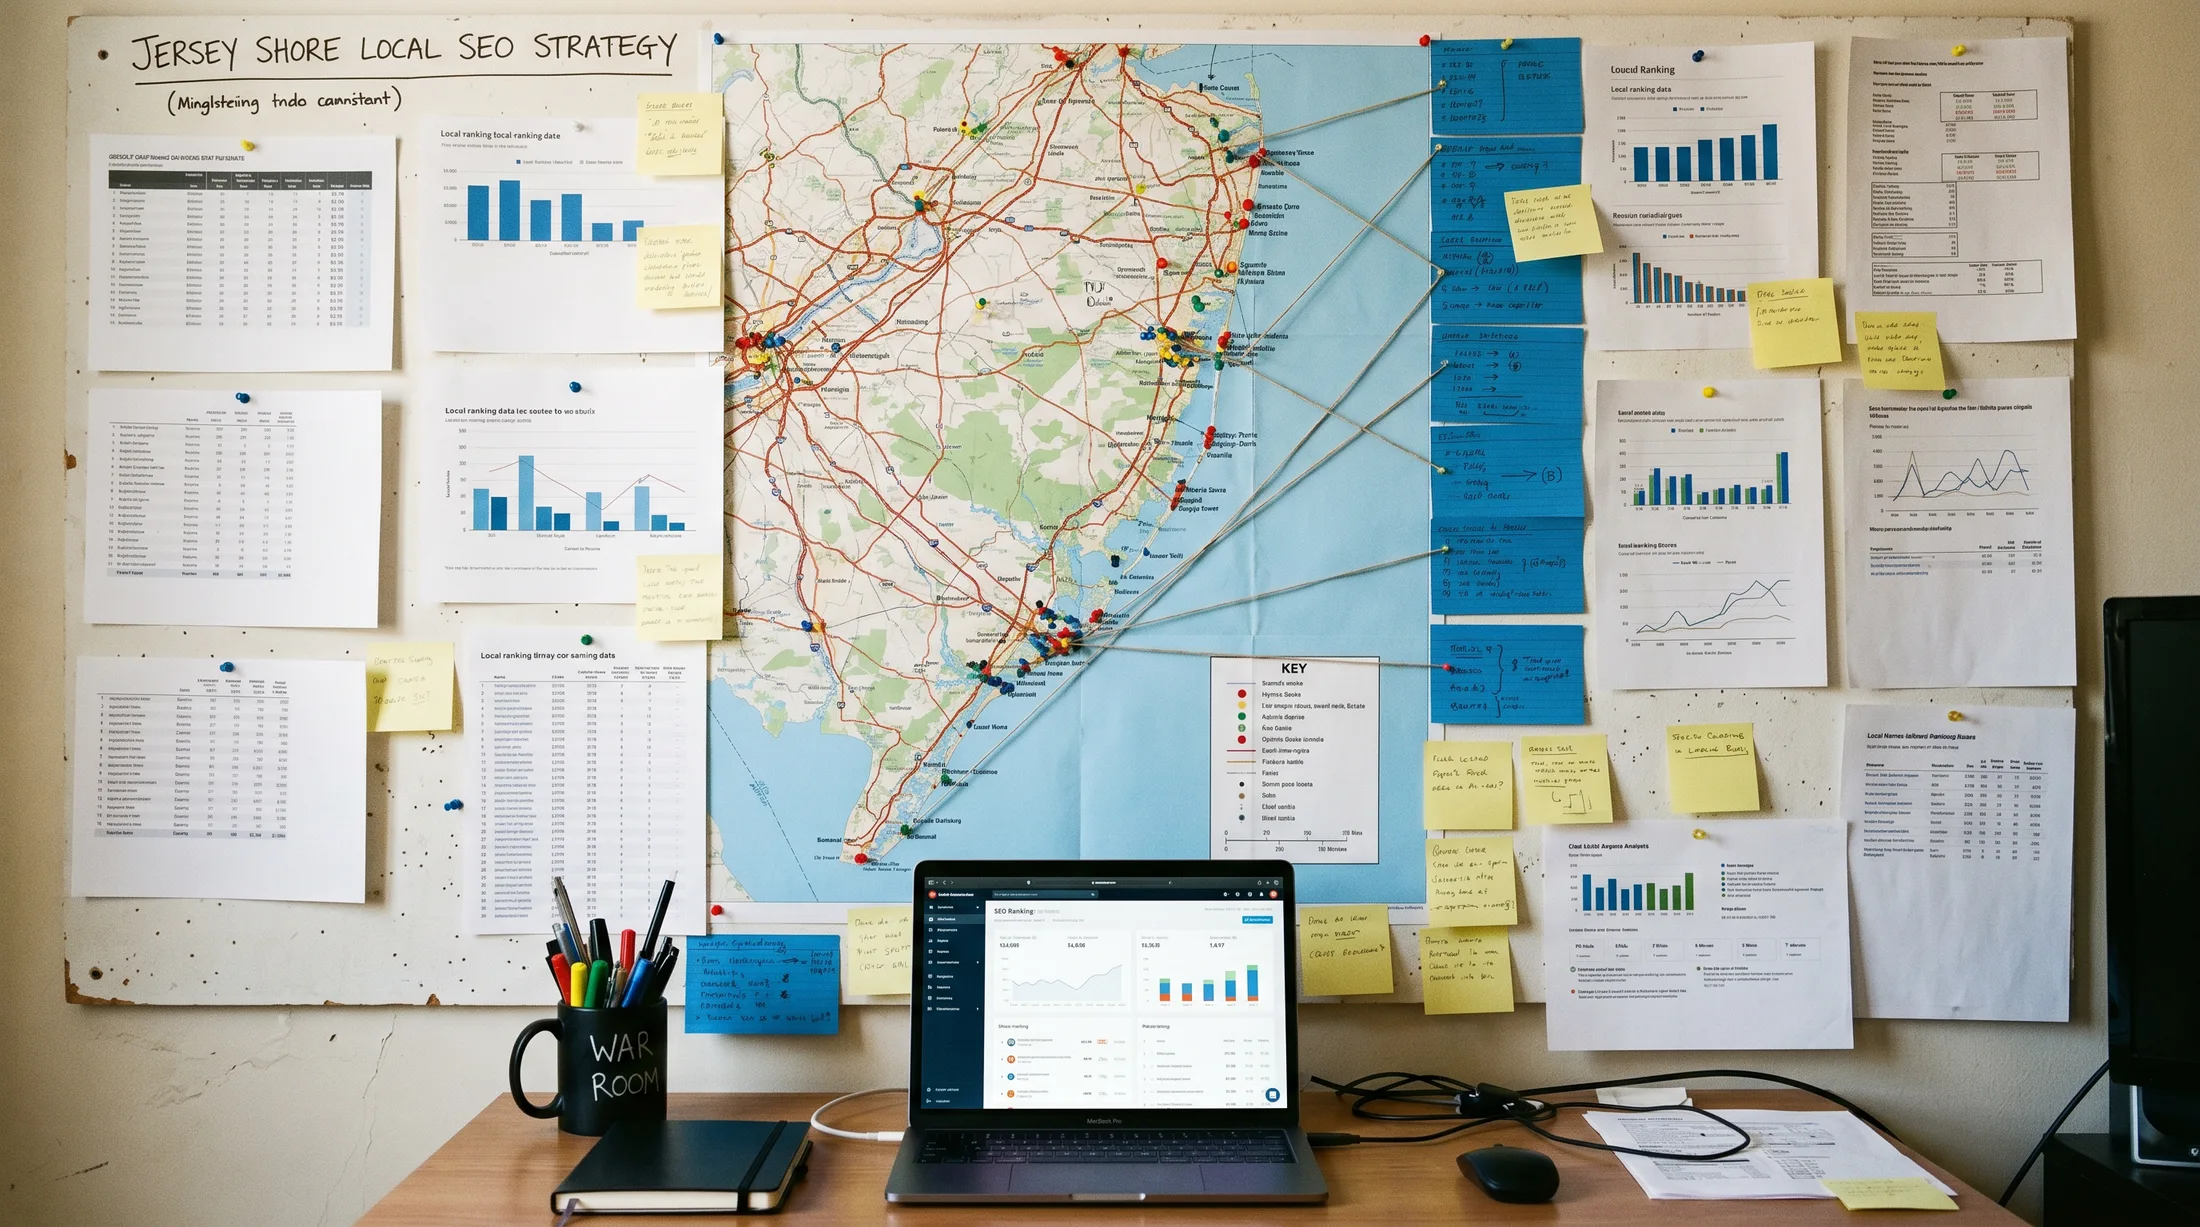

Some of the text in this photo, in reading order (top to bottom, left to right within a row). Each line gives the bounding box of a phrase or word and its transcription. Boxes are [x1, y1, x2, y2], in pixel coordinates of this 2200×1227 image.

[131, 33, 678, 71] JERSEY SHORE LOCAL SEO STRATEGY
[1640, 65, 1675, 75] Ranking
[1629, 86, 1656, 94] ranking
[440, 129, 461, 138] Local
[463, 130, 492, 140] ranking
[543, 132, 561, 140] date
[467, 407, 497, 416] ranking
[503, 652, 532, 660] ranking
[1281, 663, 1308, 674] KEY
[589, 1030, 654, 1063] WAR
[592, 1067, 660, 1101] ROOM
